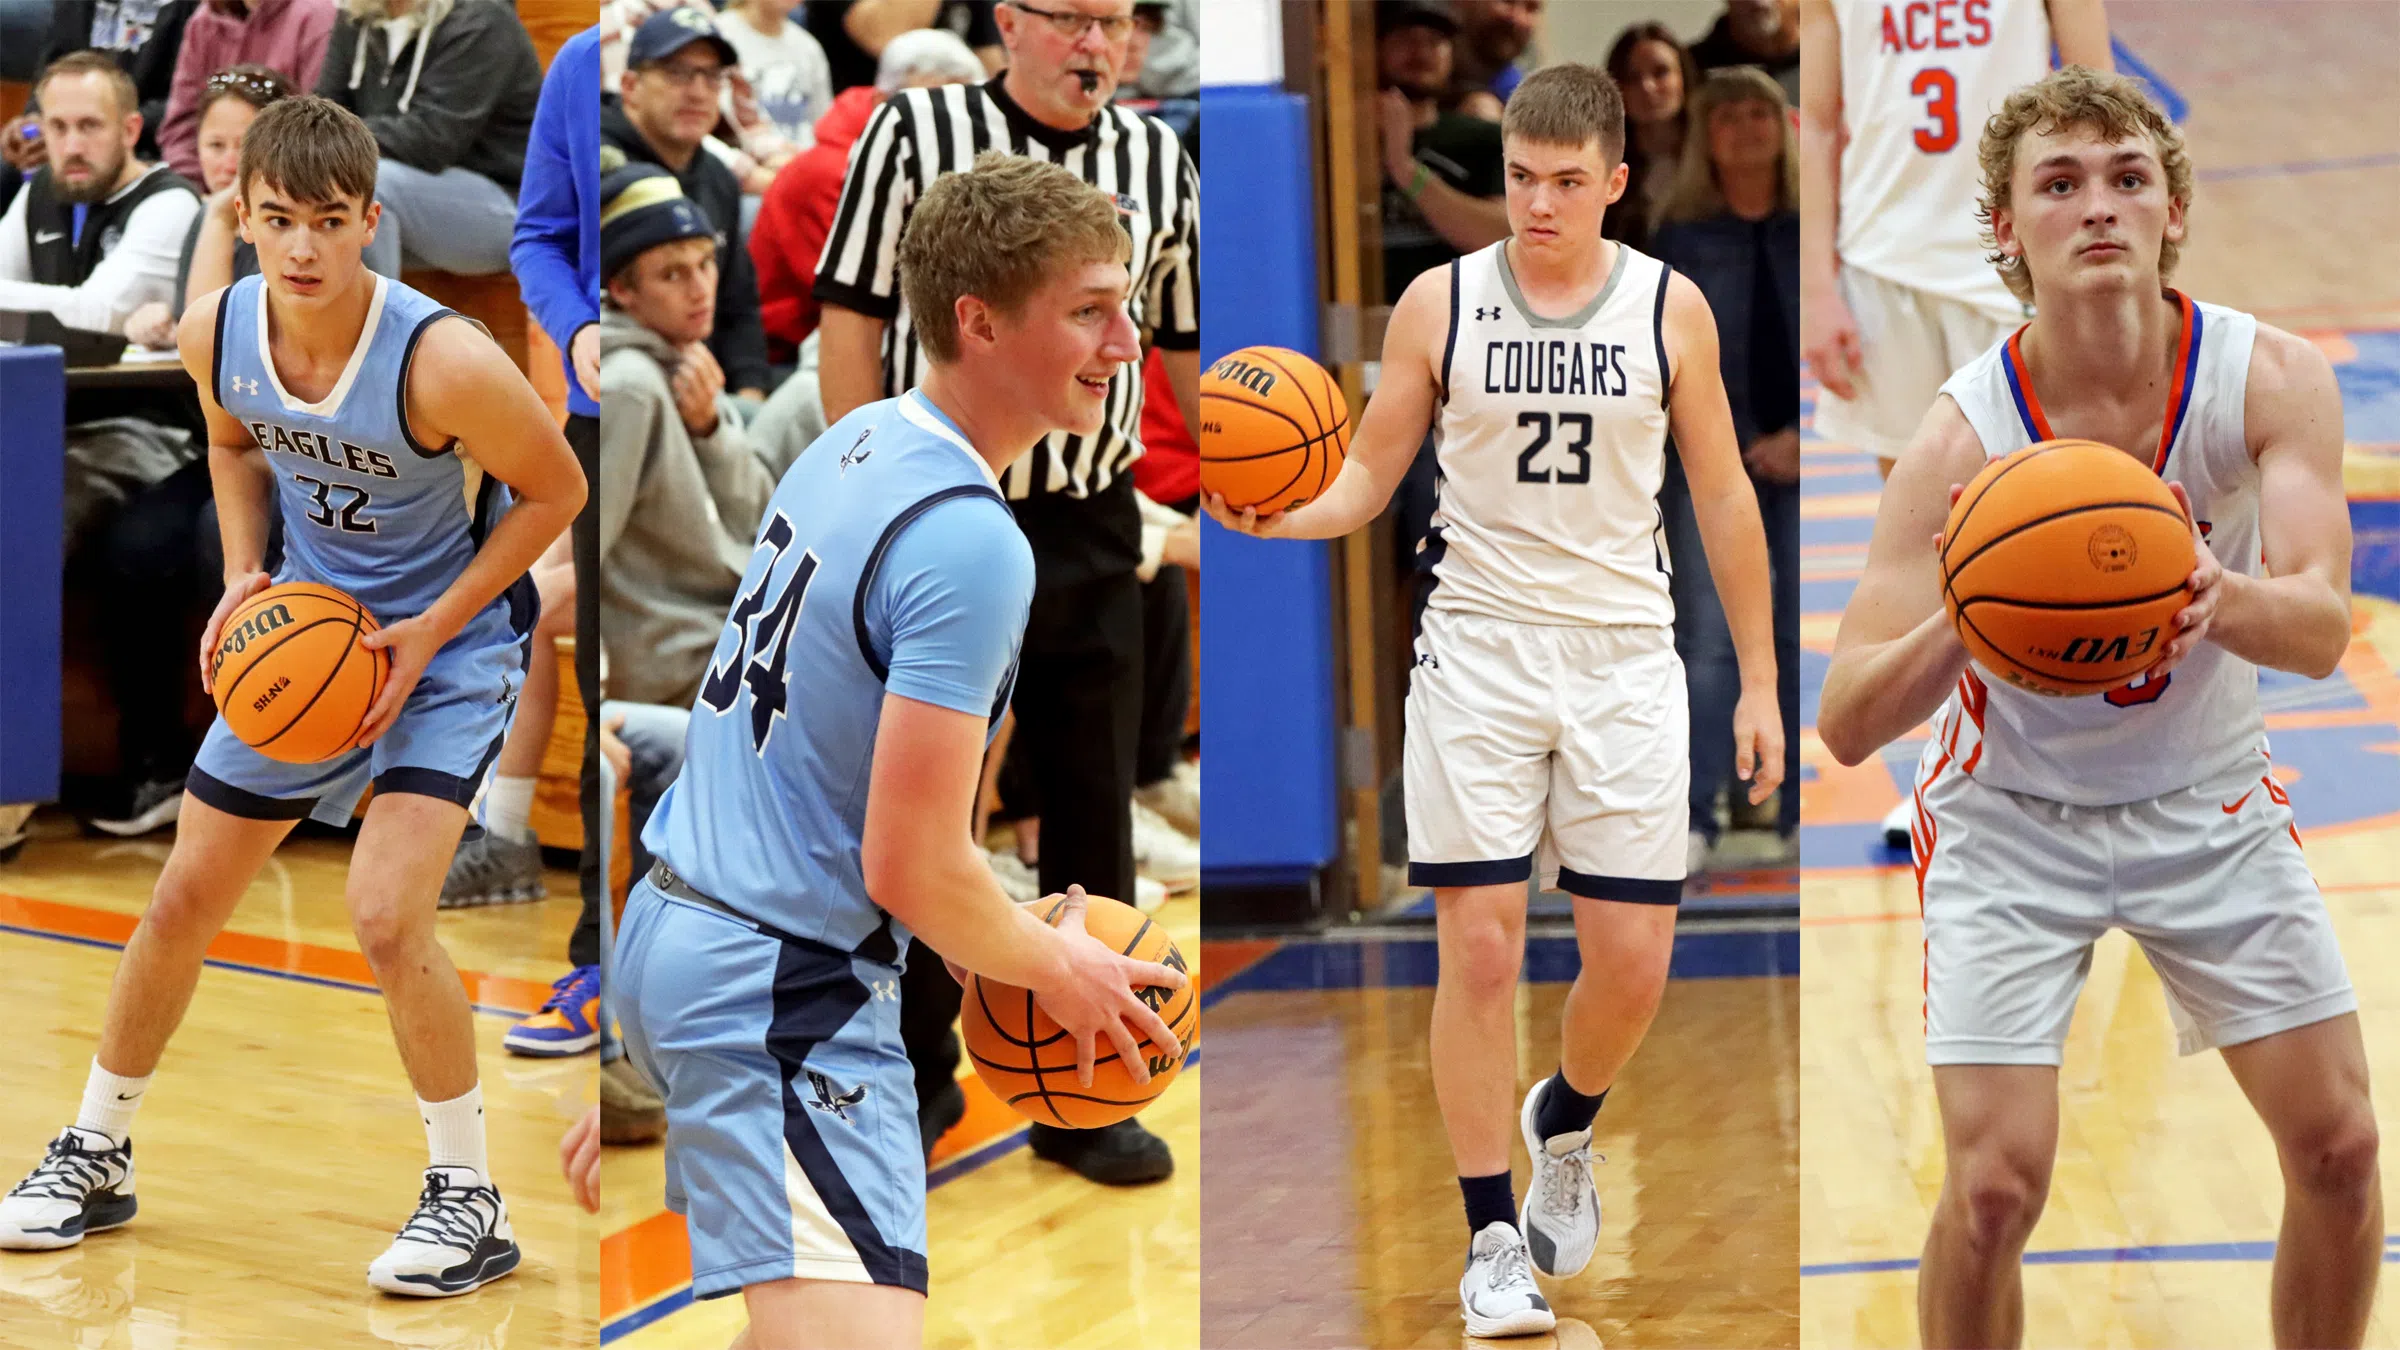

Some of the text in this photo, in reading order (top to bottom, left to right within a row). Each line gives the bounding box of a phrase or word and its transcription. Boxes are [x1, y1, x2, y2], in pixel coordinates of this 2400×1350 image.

[1881, 0, 1994, 54] ACES
[1910, 66, 1961, 155] 3
[1206, 359, 1277, 398] Wils
[1485, 341, 1627, 397] COUGARS
[250, 421, 399, 479] EAGLES
[1517, 411, 1593, 485] 23
[294, 473, 378, 535] 32
[699, 506, 822, 760] 34
[2060, 626, 2160, 664] EVO
[252, 680, 284, 713] NFHS
